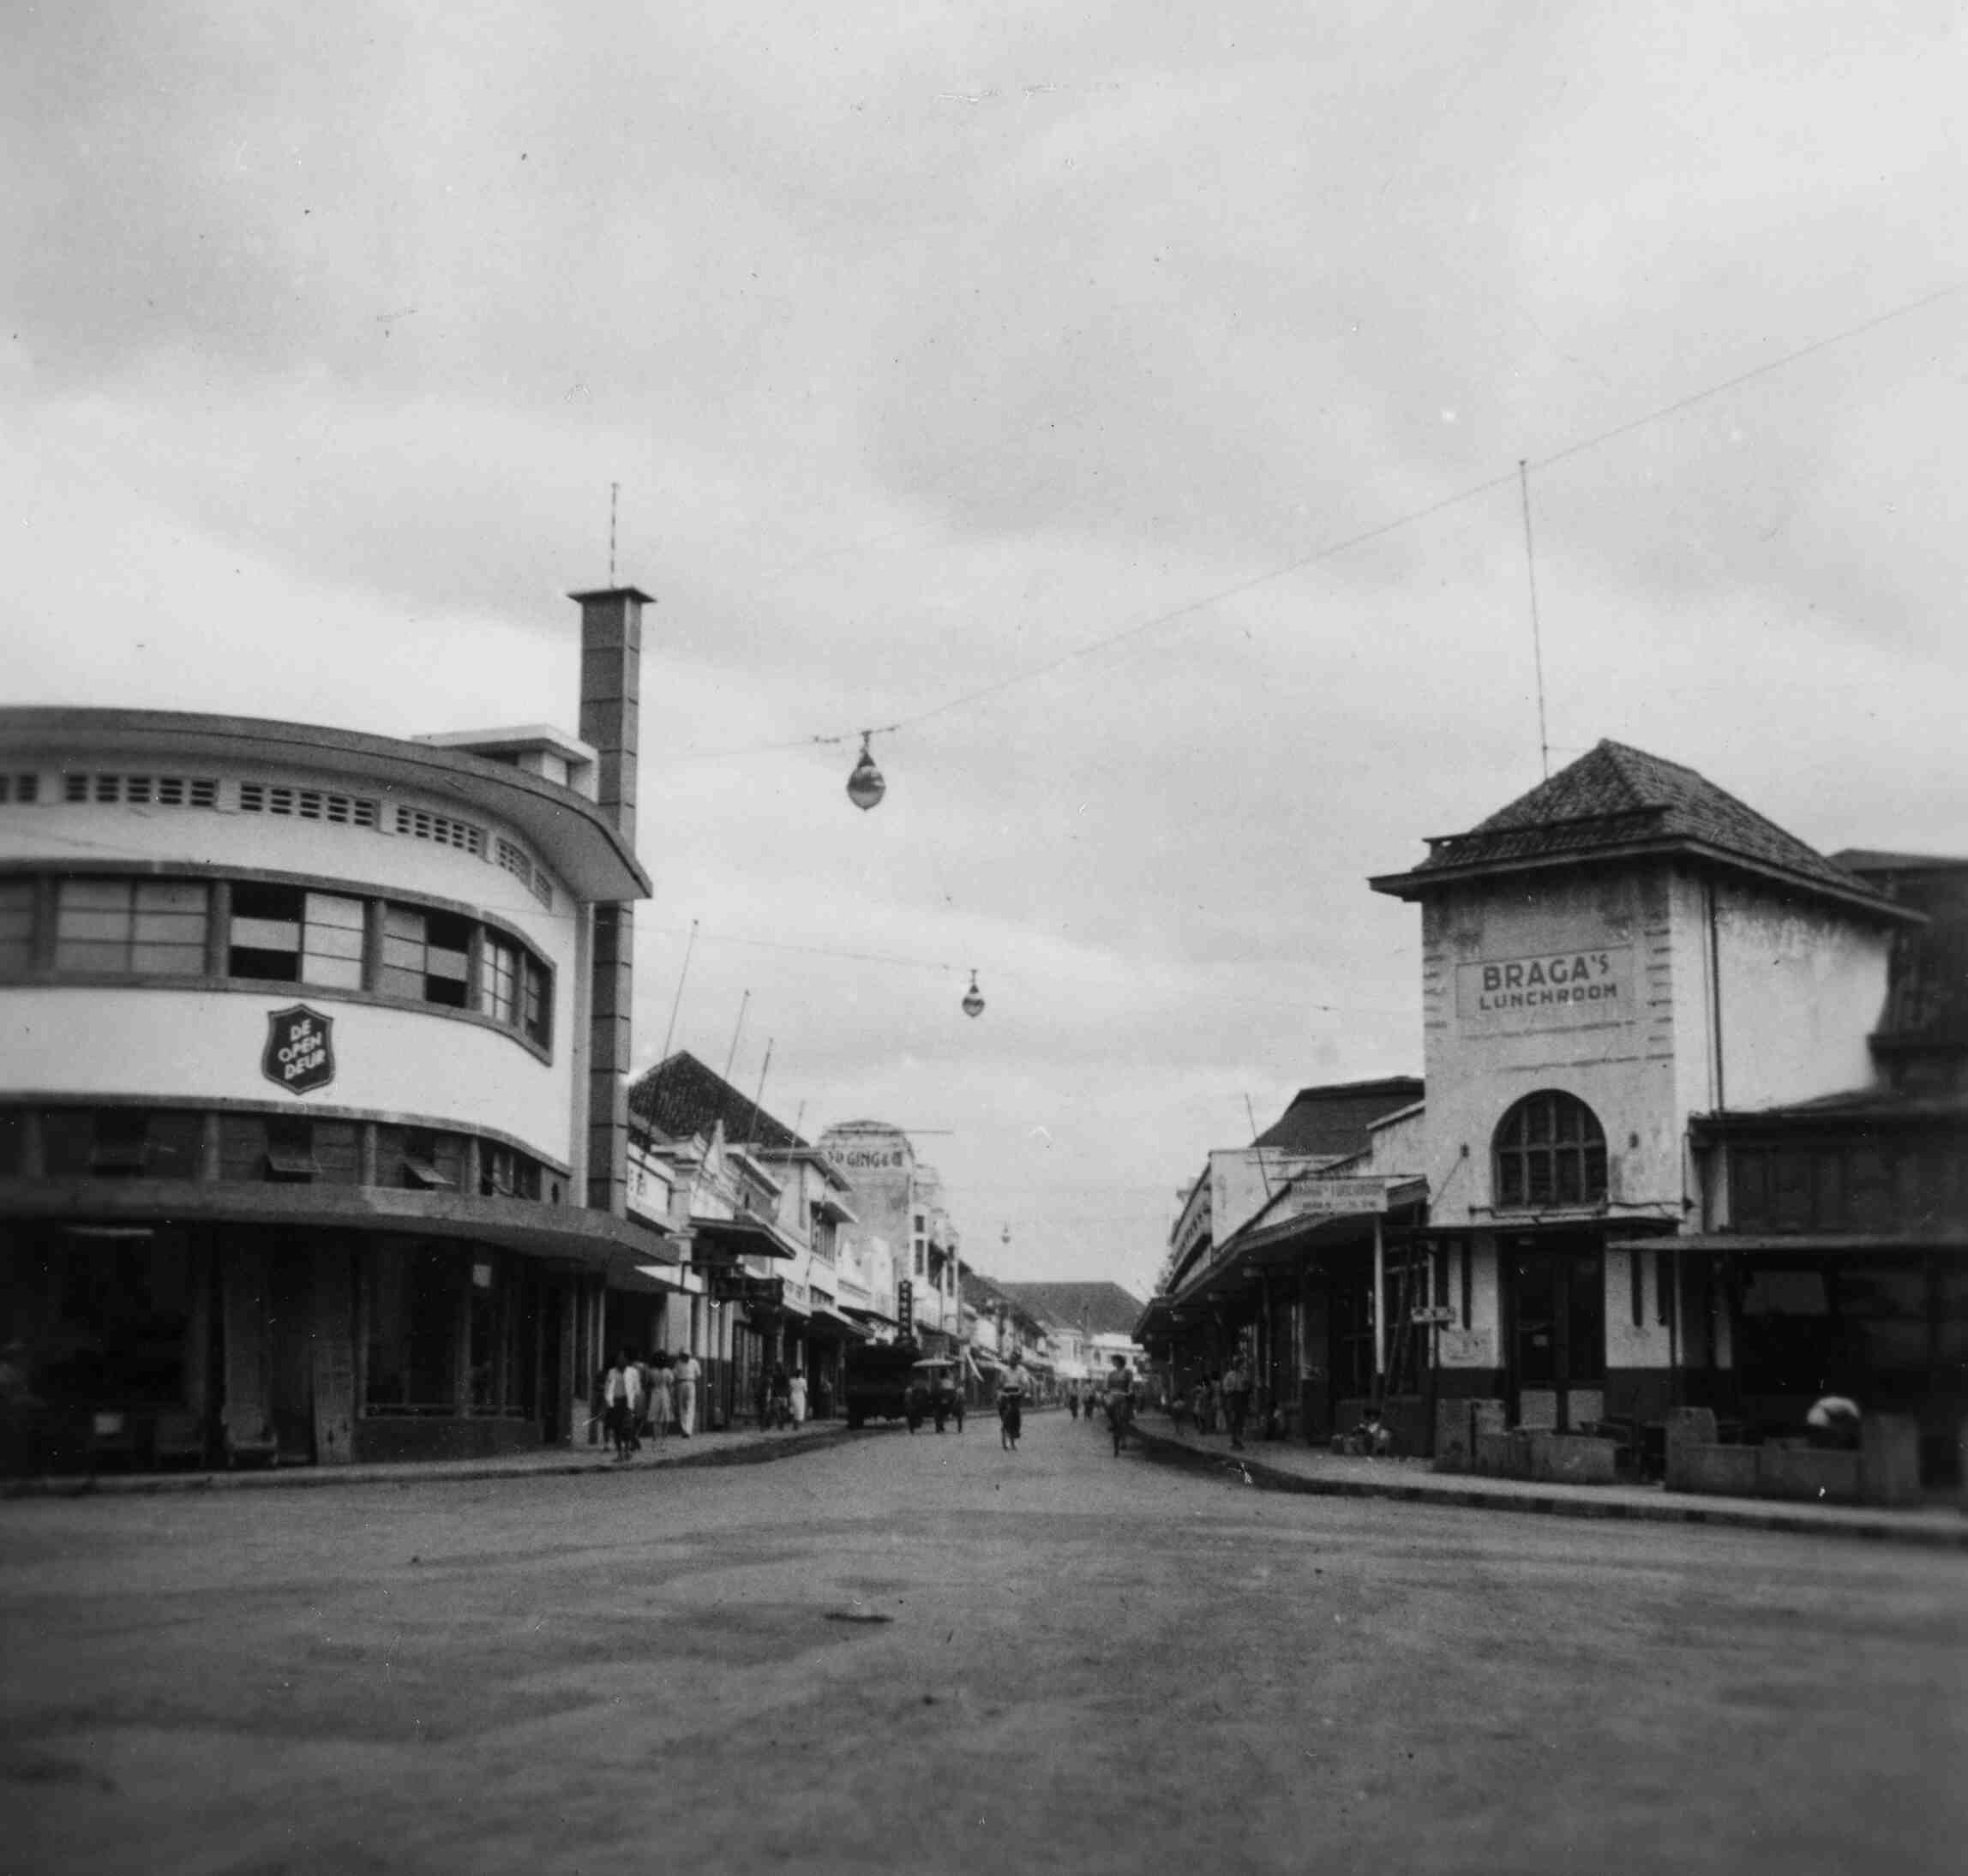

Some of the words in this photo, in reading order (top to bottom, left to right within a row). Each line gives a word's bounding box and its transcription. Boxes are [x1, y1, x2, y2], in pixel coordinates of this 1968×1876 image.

[1483, 952, 1609, 992] BRAGA'S
[1479, 982, 1617, 1011] LUNCHROOM
[290, 1017, 312, 1041] DE
[277, 1031, 322, 1063] OPEN
[284, 1048, 326, 1080] DEUR
